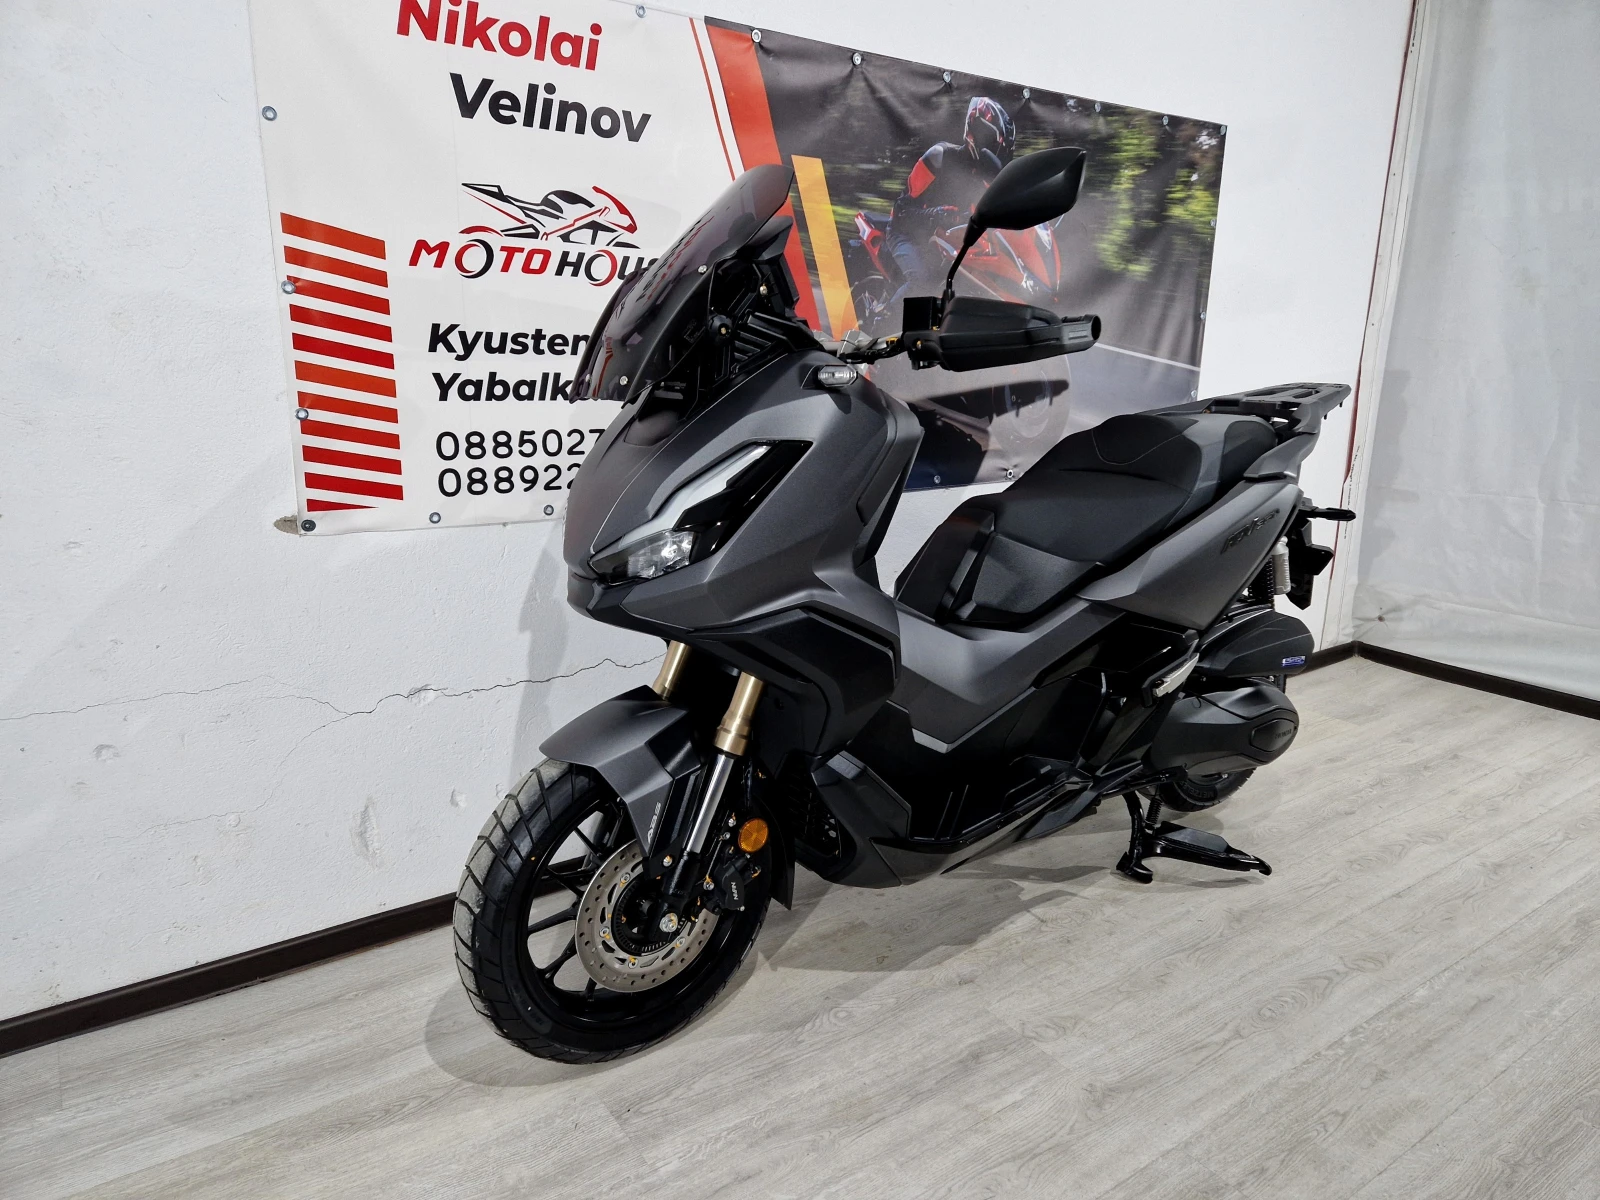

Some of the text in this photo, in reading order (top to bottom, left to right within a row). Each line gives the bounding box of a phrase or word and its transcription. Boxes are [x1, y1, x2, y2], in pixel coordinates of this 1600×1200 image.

[396, 0, 602, 71] Nikolai
[449, 72, 652, 143] Velinov
[408, 238, 552, 279] MOTO
[431, 371, 590, 401] Yabalk
[435, 428, 606, 461] 0885027
